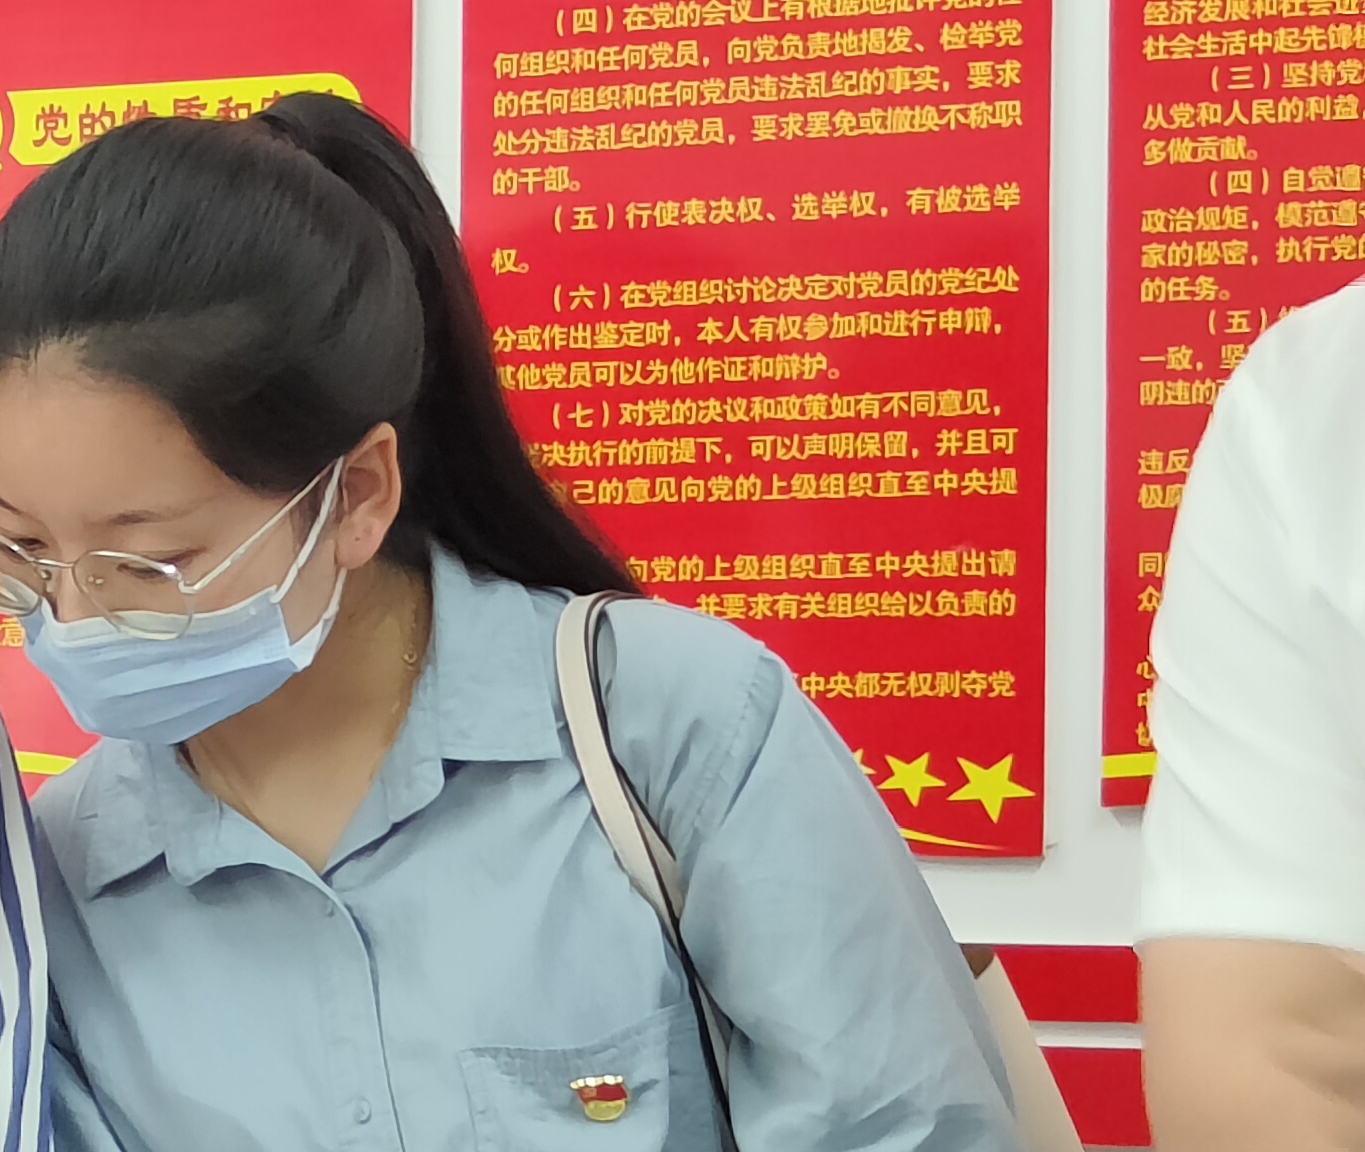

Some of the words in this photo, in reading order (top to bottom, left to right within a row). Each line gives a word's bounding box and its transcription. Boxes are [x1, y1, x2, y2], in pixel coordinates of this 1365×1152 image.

[557, 0, 1021, 36] （四）在党的会议上有根据地
[1144, 0, 1365, 26] 经济发展和社会进
[494, 18, 1022, 79] 何组织和任何党员，向党负责地揭发、检举党
[494, 59, 1022, 118] 的任何组织和任何党员违法乱纪的事实，要求
[494, 100, 1022, 156] 处分违法乱纪的党员，要求罢免或撤换不称职
[1144, 136, 1257, 165] 多做贡献。
[493, 166, 581, 195] 的干部。
[1210, 163, 1365, 196] （四）自觉遵
[555, 182, 1021, 232] （五）行使表决权、选举权，有被选举
[1142, 199, 1365, 234] 政治规矩，模范遵
[492, 248, 529, 274] 权。
[555, 265, 1020, 311] （六）在党组织讨论决定对党员的党纪处
[1141, 275, 1230, 303] 的任务。
[493, 306, 1003, 352] 分或作出鉴定时，本人有权参加和进行申辩，
[553, 388, 1003, 429] （七）对党的决议和政策如有不同意见，
[1140, 378, 1226, 406] 阴违的
[1138, 448, 1190, 475] 违反
[553, 467, 1018, 504] 己的意见向党的上级组织直至中央提
[653, 588, 1017, 620] 并要求有关组织给以负责的
[793, 667, 1016, 700] 中央都无权剥夺党
